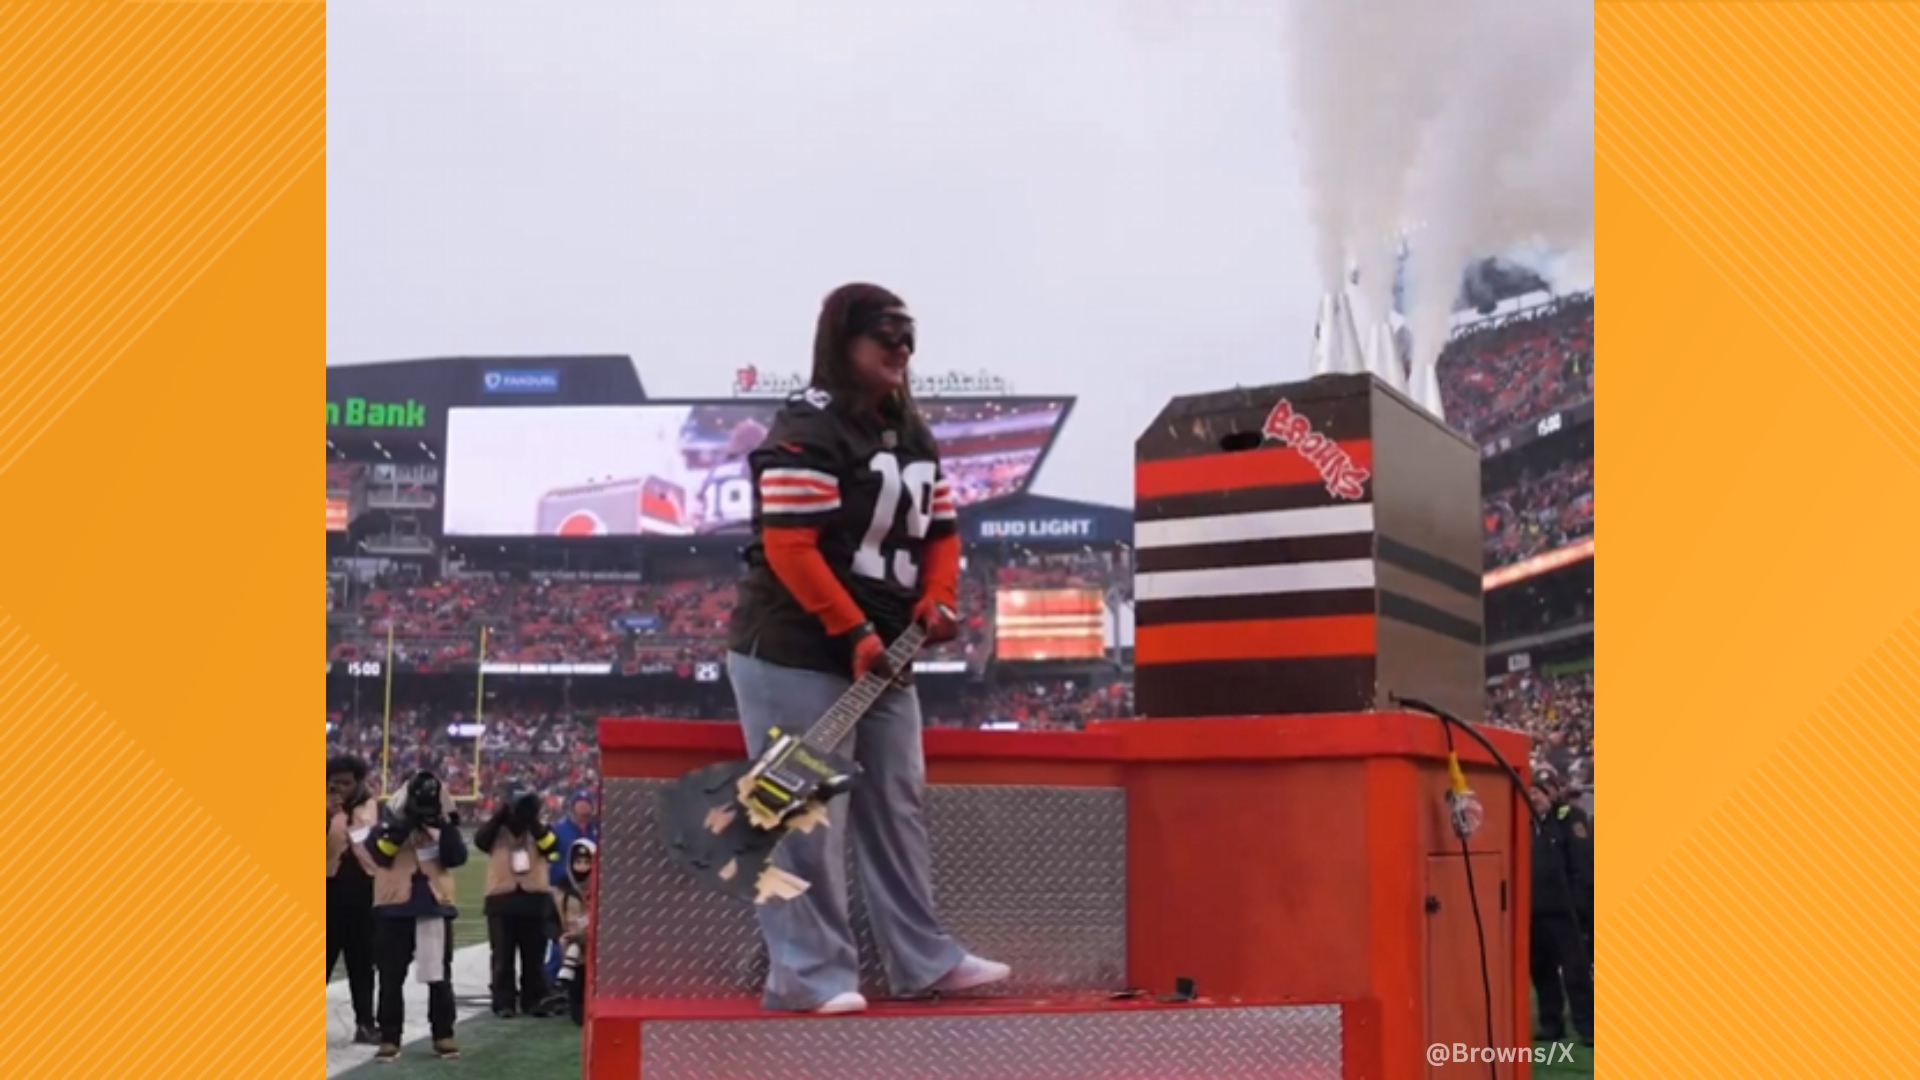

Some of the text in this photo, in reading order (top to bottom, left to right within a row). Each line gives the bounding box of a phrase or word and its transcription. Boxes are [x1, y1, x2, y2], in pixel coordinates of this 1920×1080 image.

[346, 397, 426, 426] Bank
[1262, 397, 1370, 499] BROWNS
[852, 451, 937, 588] 19
[980, 518, 1091, 538] BUD LIGHT
